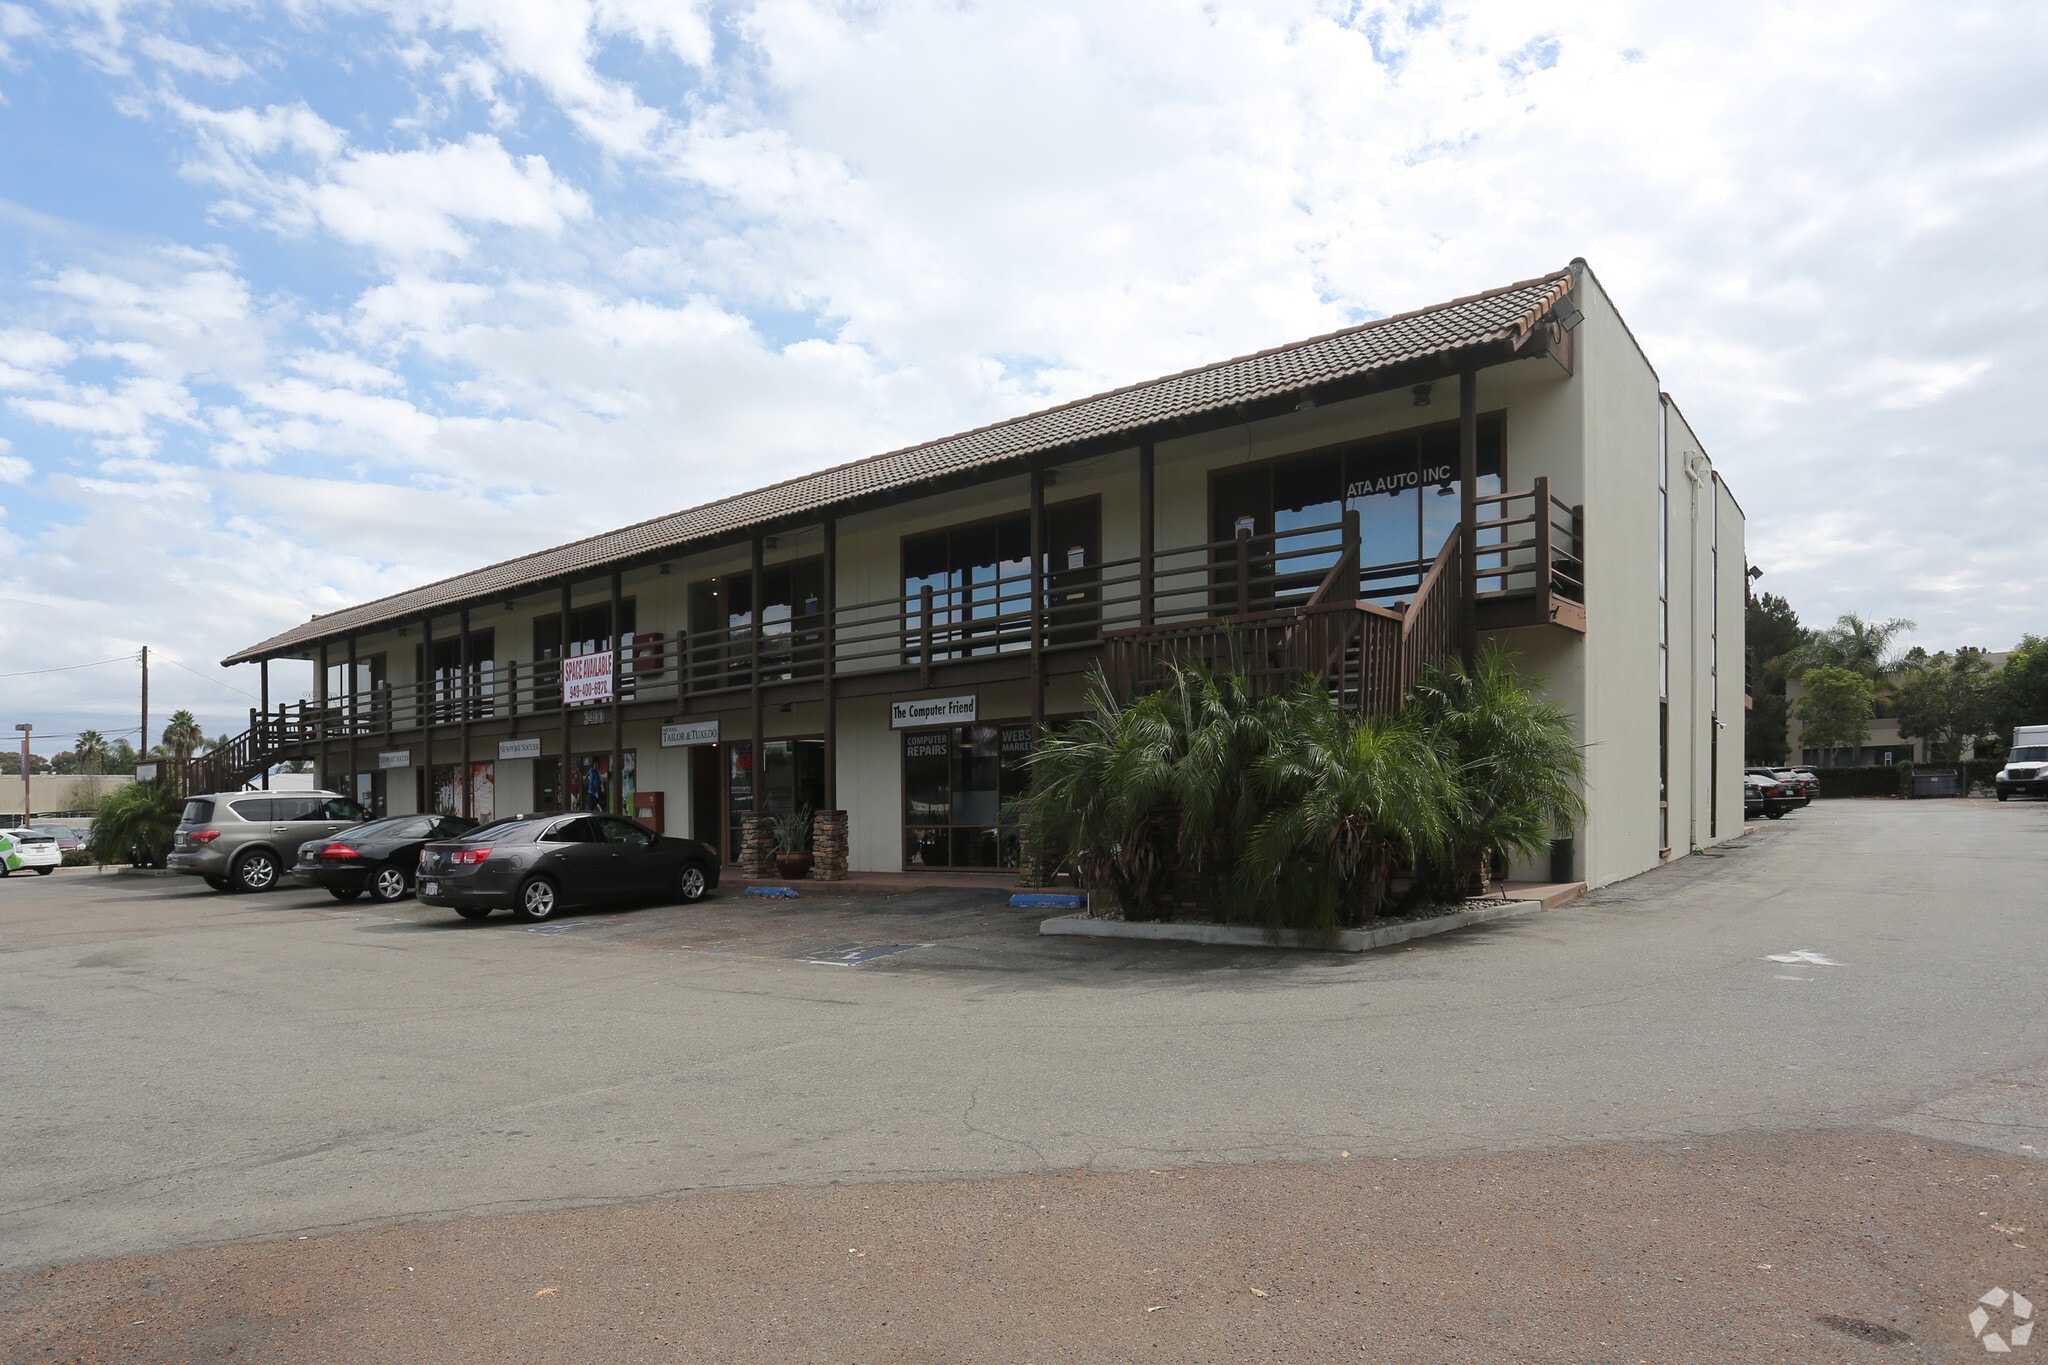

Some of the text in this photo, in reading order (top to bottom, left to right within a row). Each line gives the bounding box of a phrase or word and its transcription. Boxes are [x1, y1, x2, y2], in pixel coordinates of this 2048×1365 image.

[1346, 465, 1450, 497] ATA AUTO INC
[565, 654, 612, 682] SPACE AVAILABLE
[893, 698, 974, 720] The Computer Friend
[663, 728, 718, 743] TAILOR & TUXEDO
[907, 735, 947, 746] COMPUTER
[907, 744, 947, 757] REPAIRS
